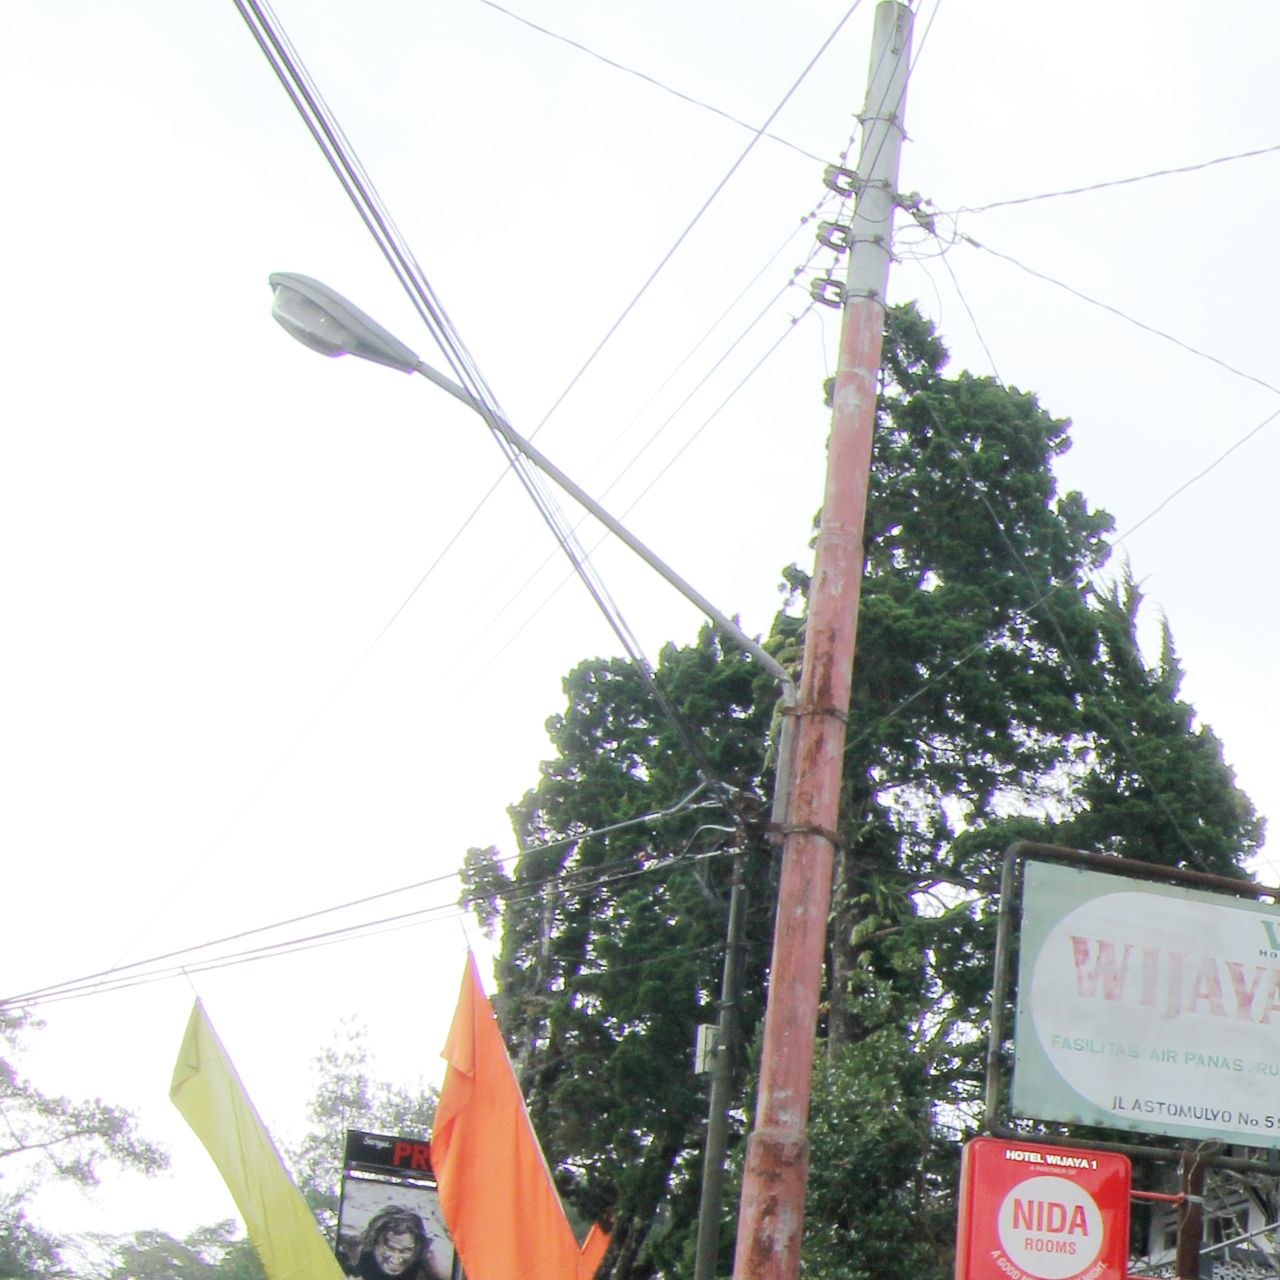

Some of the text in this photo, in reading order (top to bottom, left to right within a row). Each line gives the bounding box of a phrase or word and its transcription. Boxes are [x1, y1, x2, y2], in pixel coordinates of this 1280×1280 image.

[1051, 1034, 1139, 1058] FASILITAS
[1150, 1048, 1178, 1064] AIR
[1131, 1099, 1232, 1123] ASTOMULYO
[1006, 1149, 1098, 1170] HOTEL WIJAYA 1
[1012, 1198, 1089, 1237] NIDA
[1024, 1238, 1077, 1256] ROOMS
[991, 1249, 1001, 1259] A
[996, 1257, 1021, 1280] GOOD
